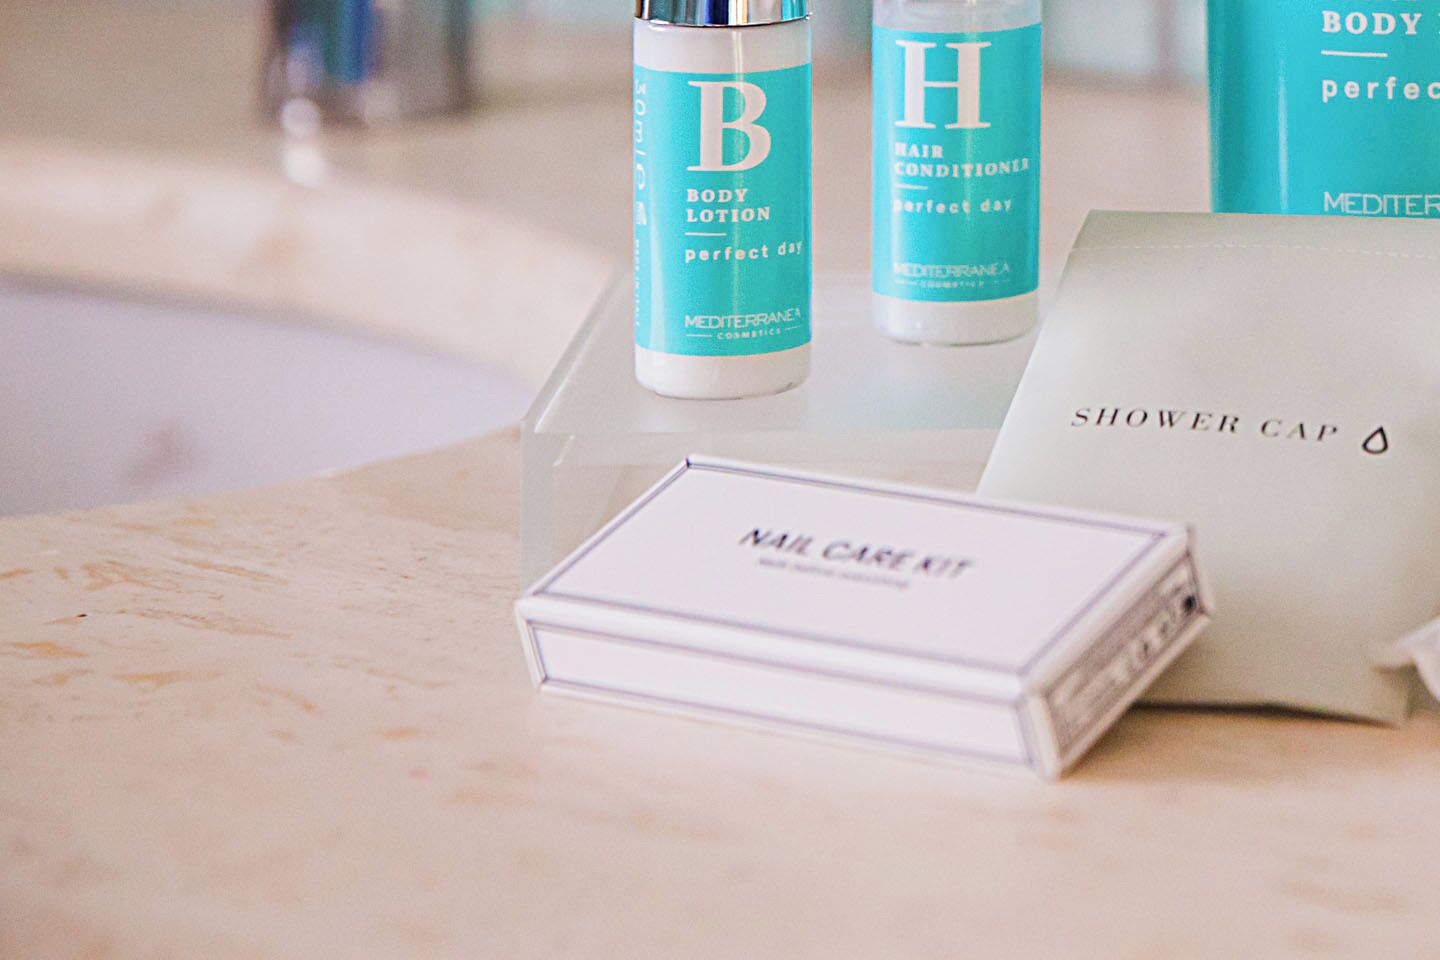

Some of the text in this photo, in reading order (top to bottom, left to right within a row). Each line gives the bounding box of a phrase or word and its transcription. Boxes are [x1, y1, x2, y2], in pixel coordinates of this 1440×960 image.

[1322, 10, 1422, 35] BODY
[895, 39, 992, 129] H
[687, 80, 772, 171] B
[894, 142, 944, 158] HAIR
[894, 158, 1030, 178] CONDITIONER
[686, 189, 749, 203] BODY
[893, 198, 1013, 215] perfect day
[686, 206, 770, 223] LOTION
[685, 240, 804, 263] perfect day
[684, 308, 801, 329] MEDITERRANEA
[716, 328, 781, 340] COSMETICS
[1070, 406, 1339, 442] SHOWER CAP
[739, 527, 813, 556] NAIL
[822, 539, 916, 570] CARE
[913, 555, 976, 579] KIT
